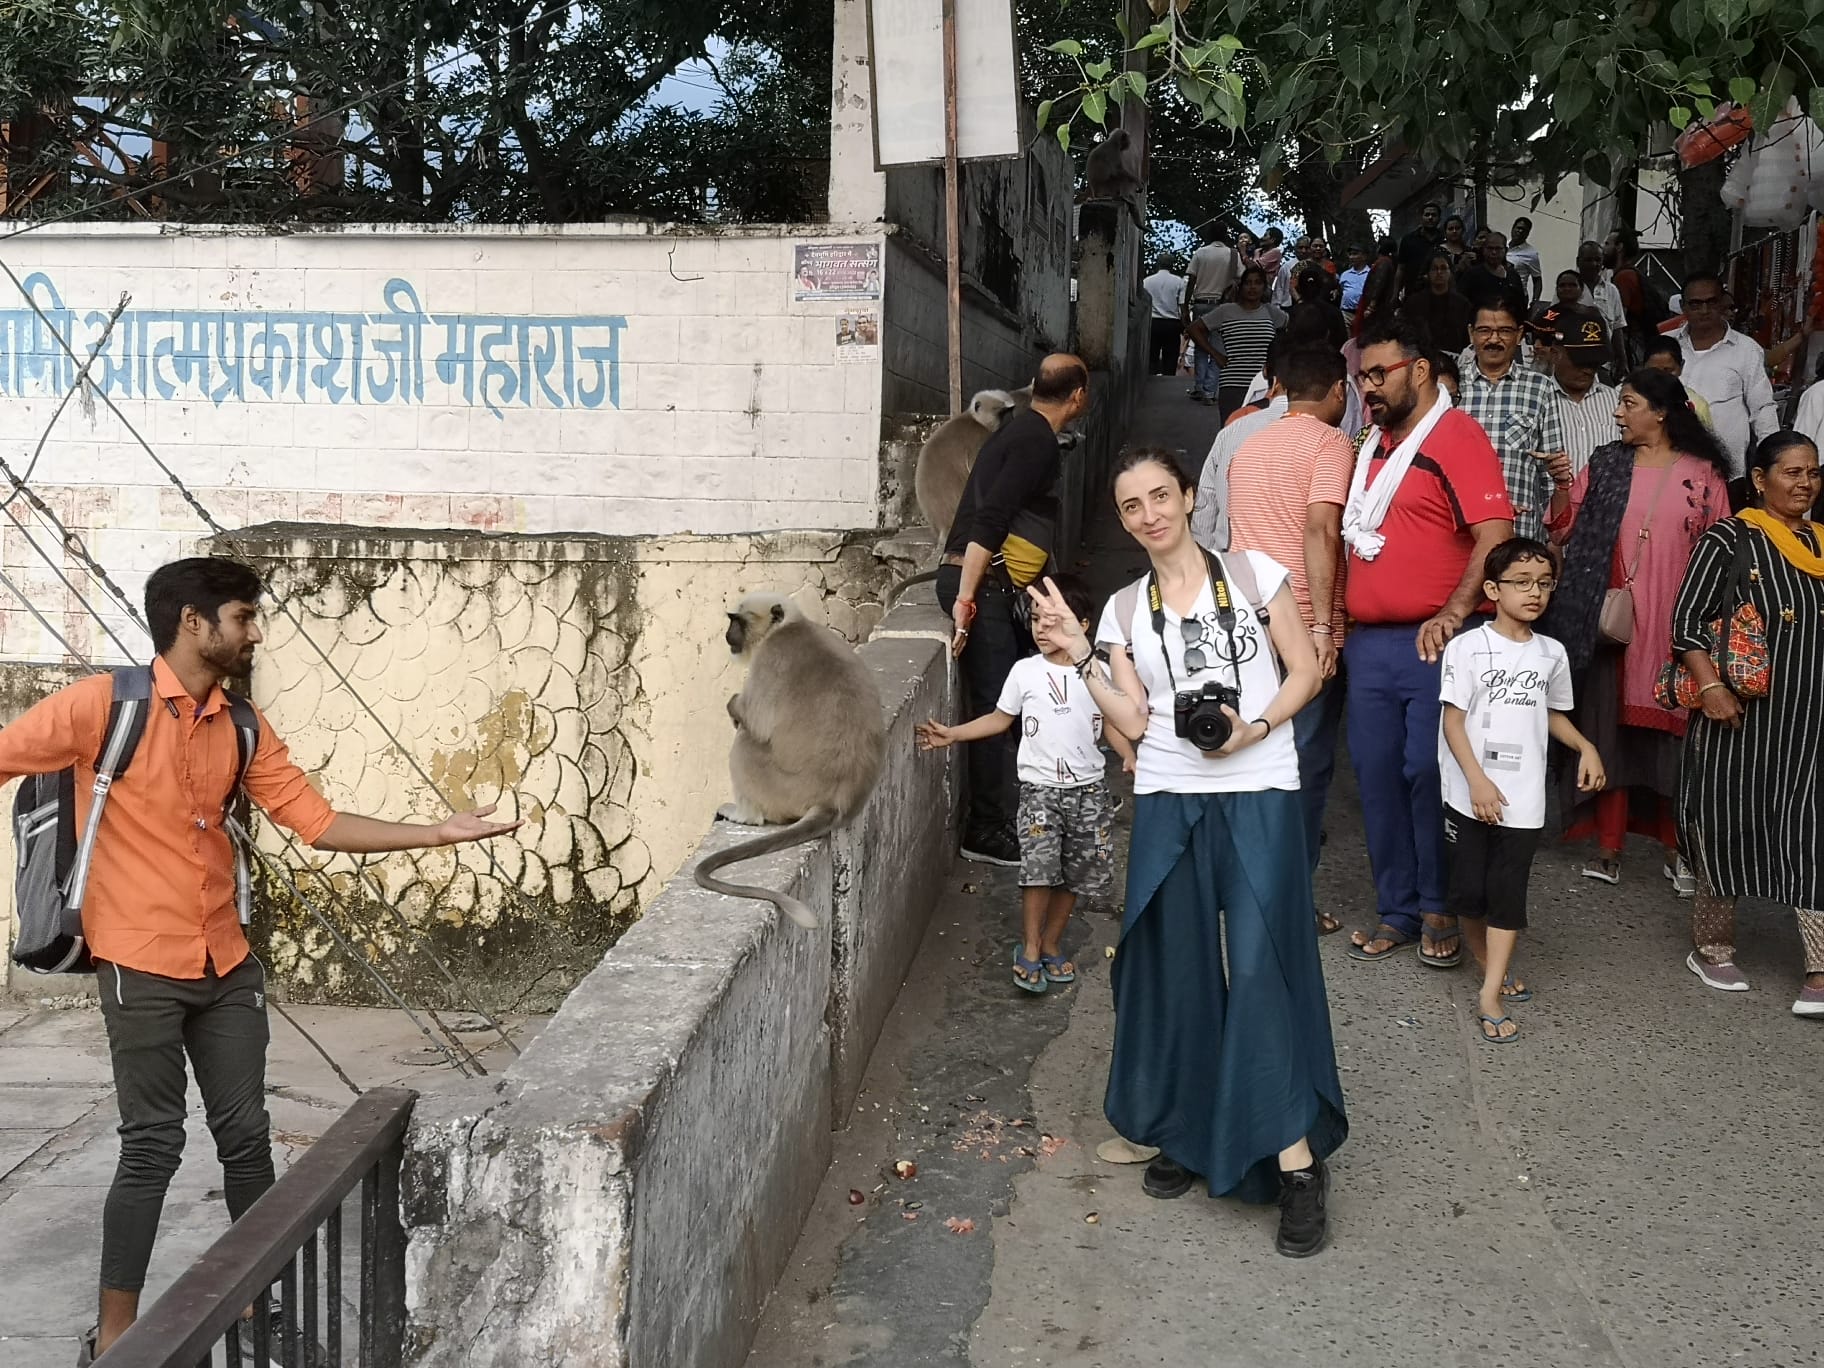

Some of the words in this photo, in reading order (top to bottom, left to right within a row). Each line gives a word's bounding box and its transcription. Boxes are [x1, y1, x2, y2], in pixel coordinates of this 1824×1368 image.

[815, 260, 848, 269] भागवत
[431, 314, 628, 421] महाराज
[1215, 580, 1229, 607] Nikon
[1488, 687, 1537, 708] London
